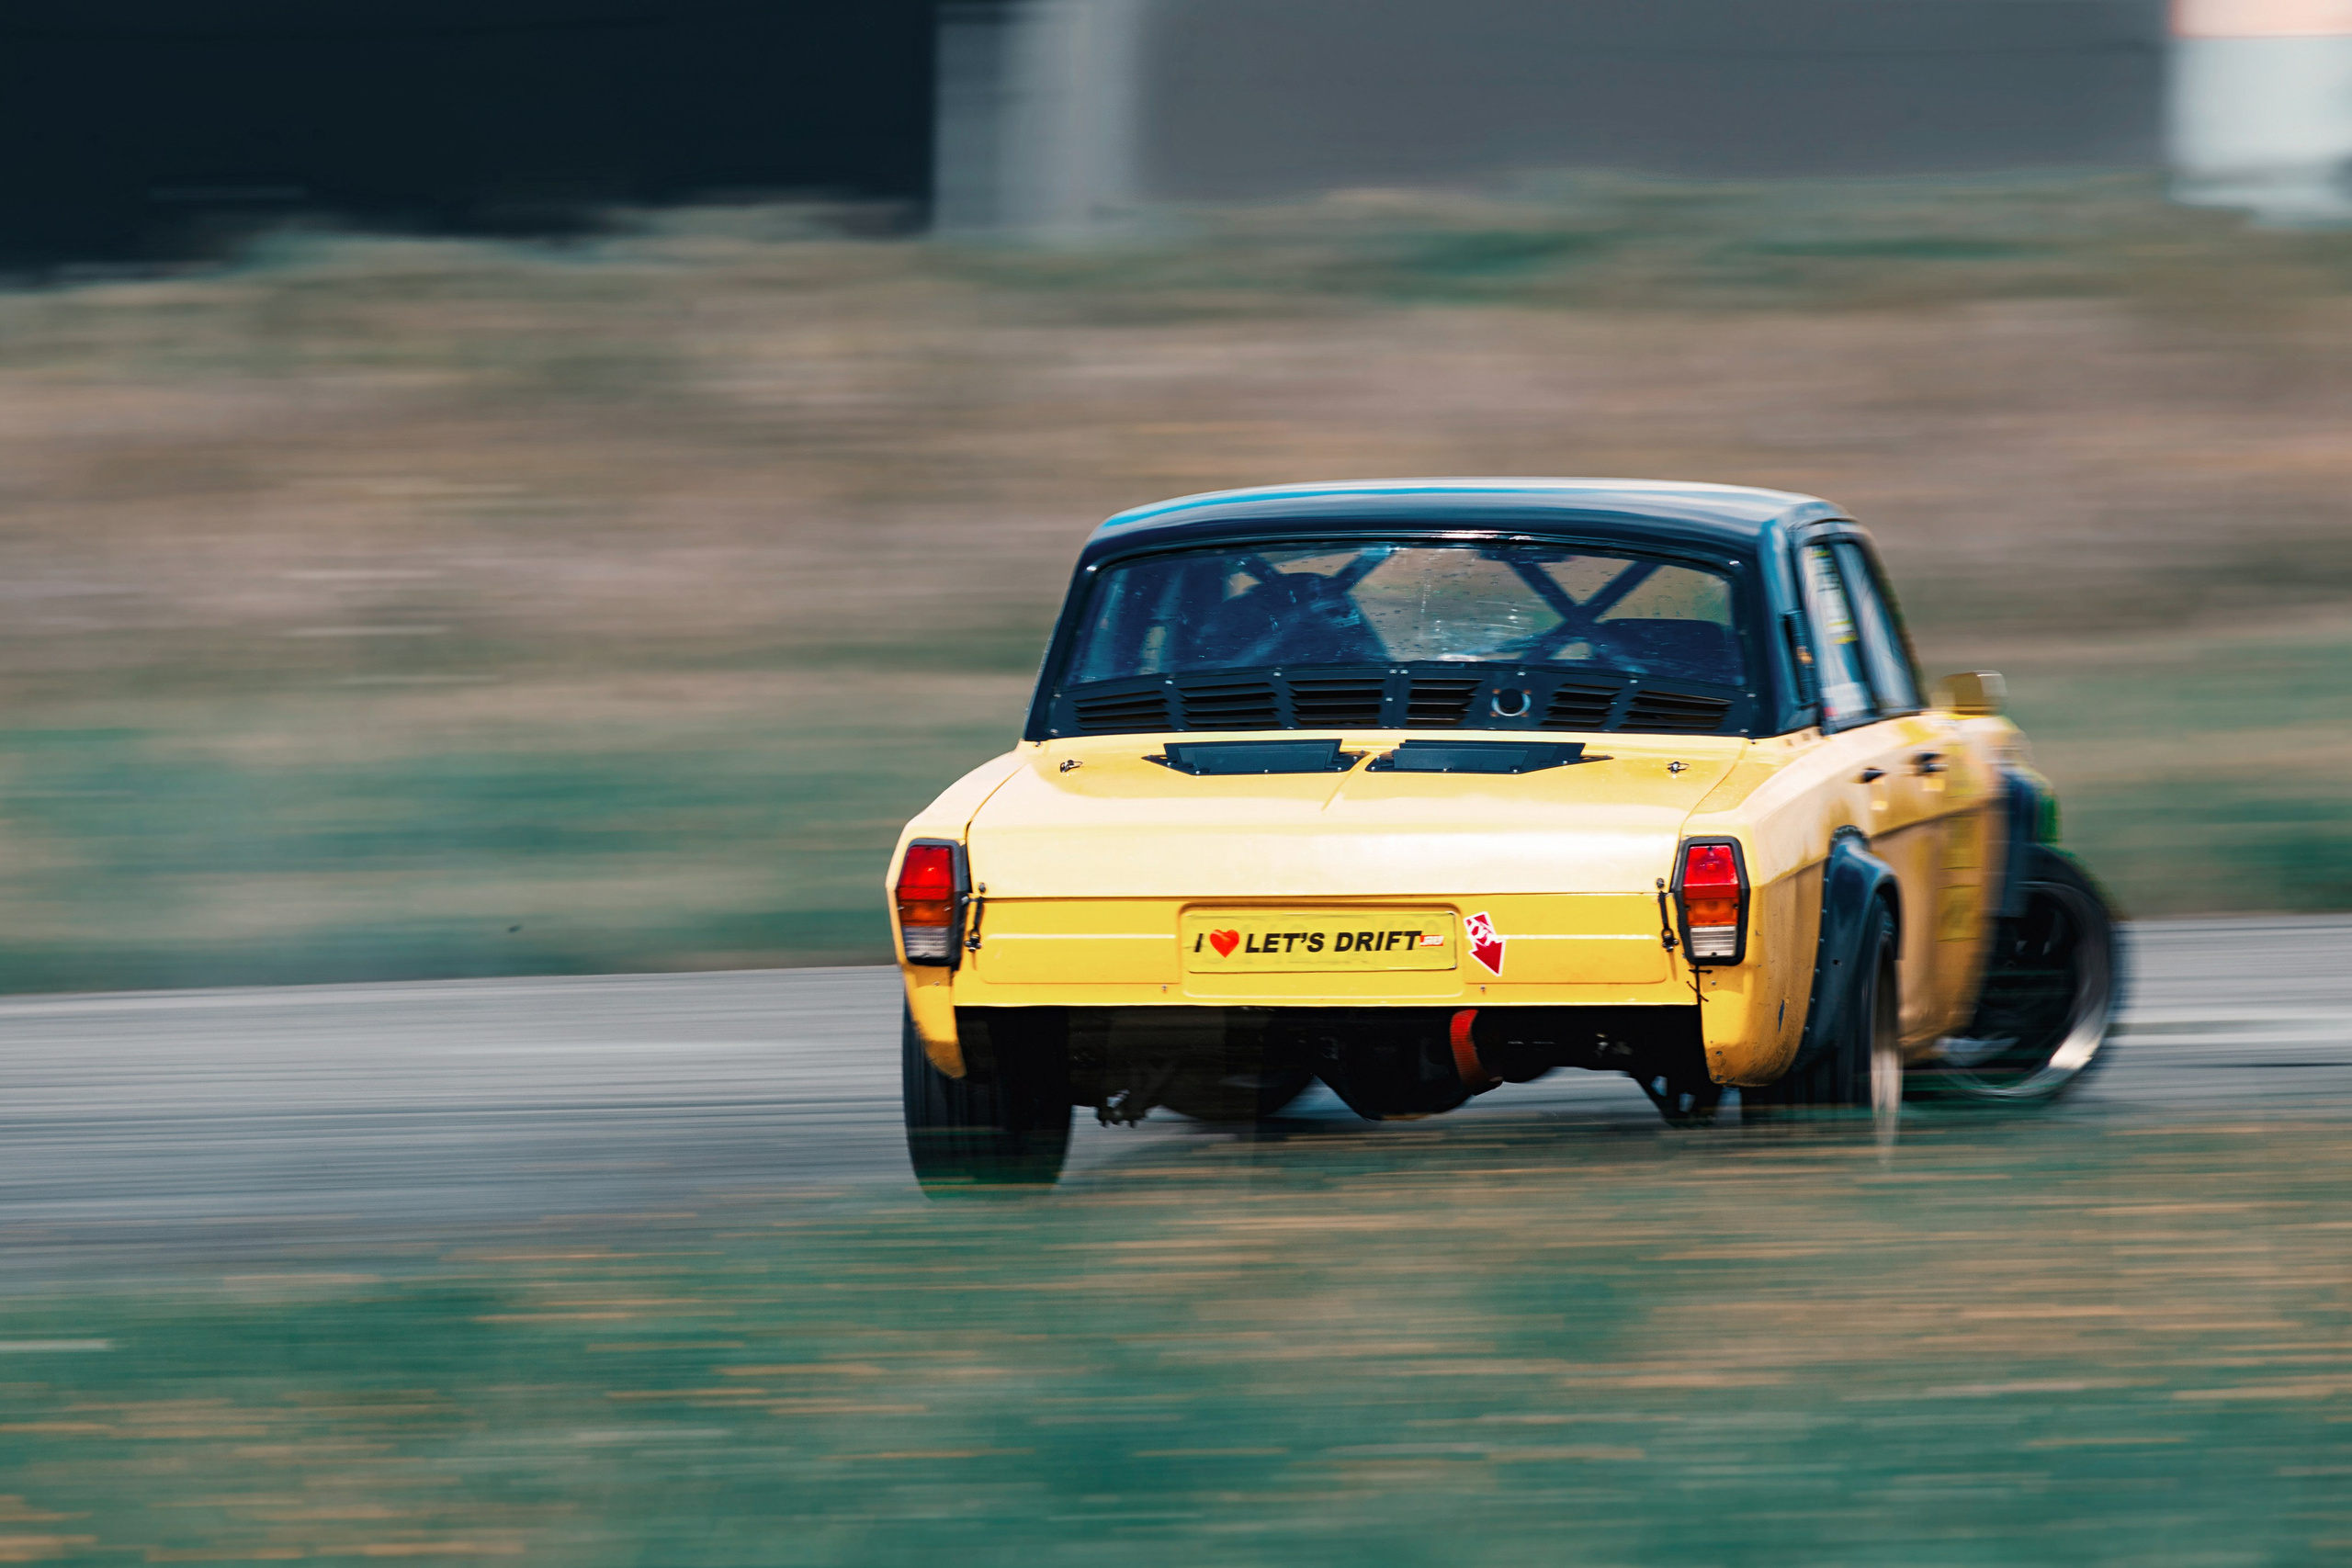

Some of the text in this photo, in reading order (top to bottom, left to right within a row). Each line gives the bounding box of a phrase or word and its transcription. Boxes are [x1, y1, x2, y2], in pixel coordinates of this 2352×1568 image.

[1193, 932, 1204, 953] I
[1245, 932, 1325, 953] LET'S
[1334, 931, 1422, 953] DRIFT
